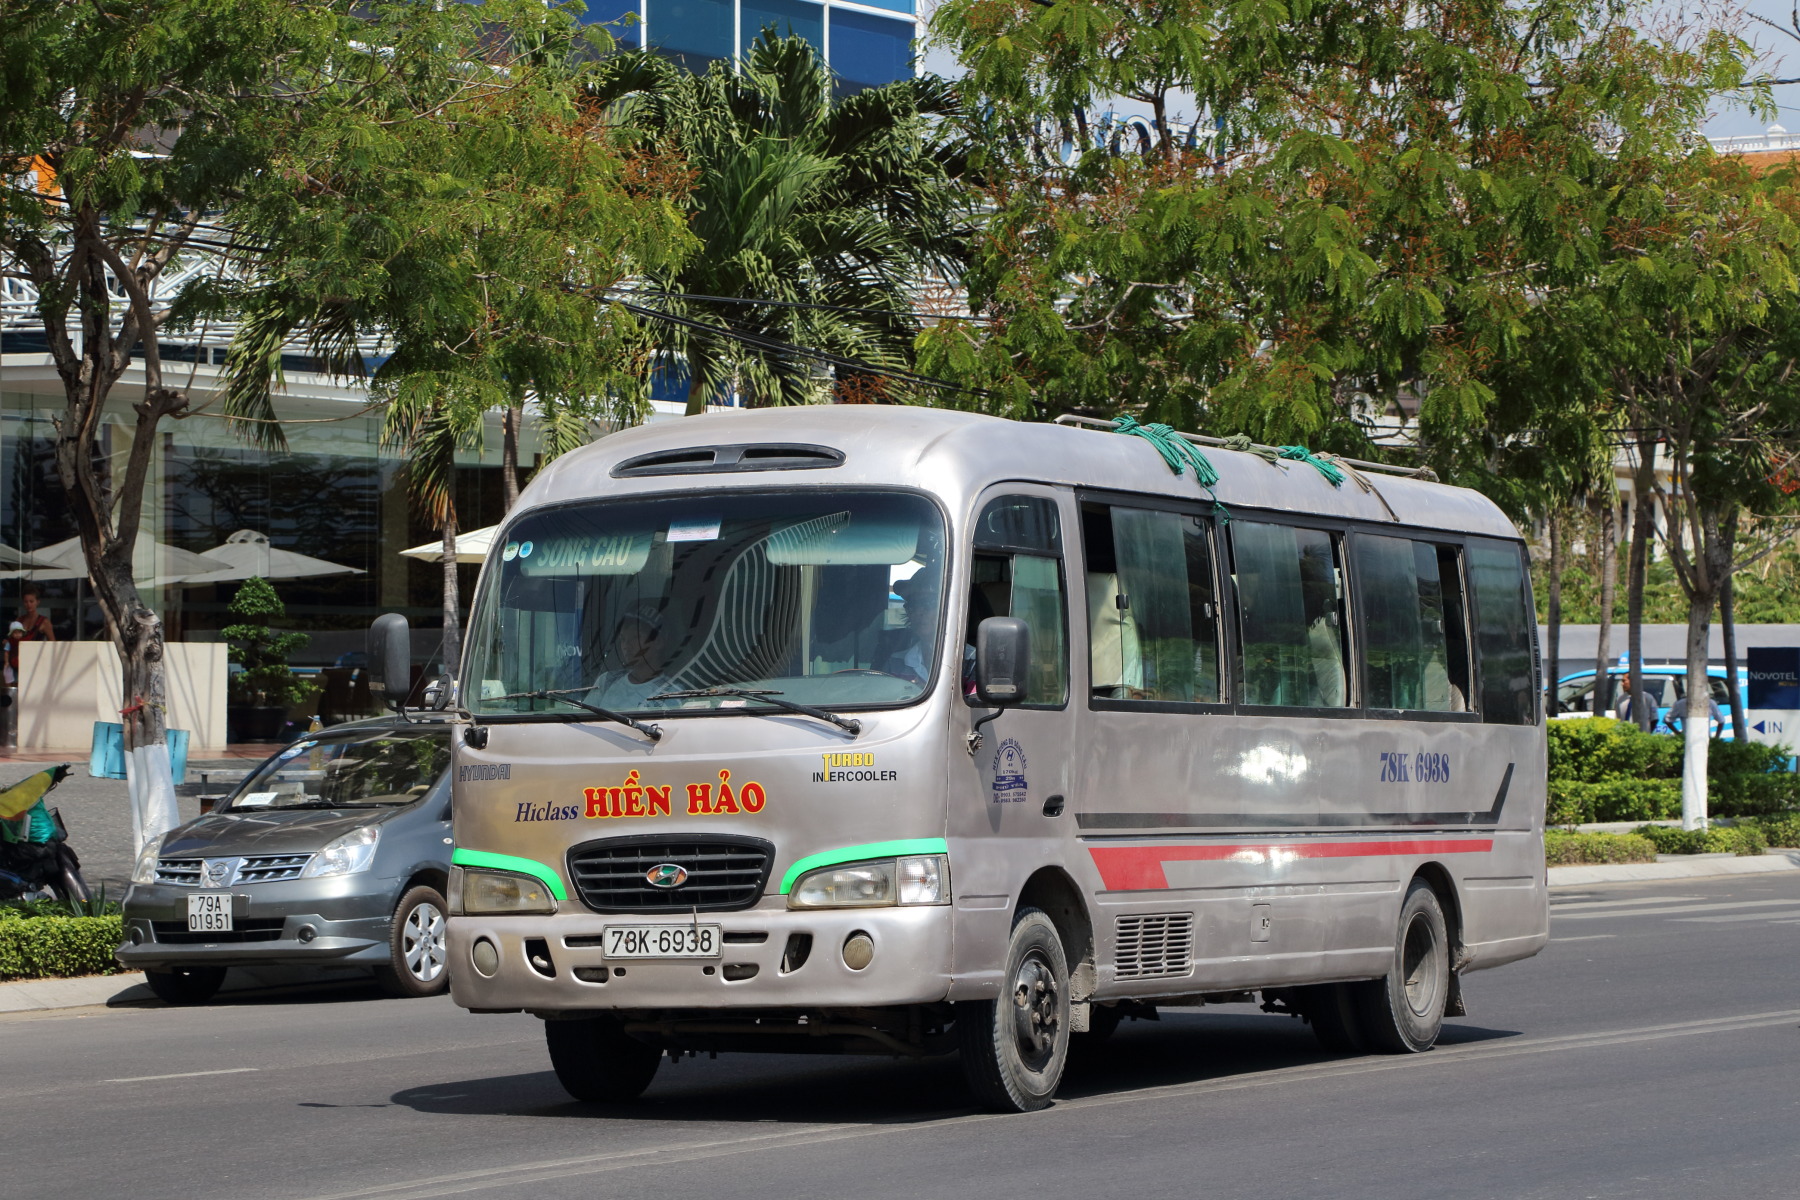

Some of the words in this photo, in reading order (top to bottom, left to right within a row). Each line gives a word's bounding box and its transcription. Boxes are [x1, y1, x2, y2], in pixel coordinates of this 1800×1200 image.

[1750, 672, 1798, 680] NOVOTEL
[1768, 721, 1783, 733] IN
[459, 764, 512, 782] HYUNDAI
[812, 770, 897, 783] INTERCOOLER
[822, 753, 875, 782] TURBO
[582, 769, 673, 818] HIỀN
[685, 768, 767, 816] HẢO
[514, 800, 579, 823] Hiclass
[198, 896, 222, 912] 79A
[611, 929, 713, 954] 78K-6938
